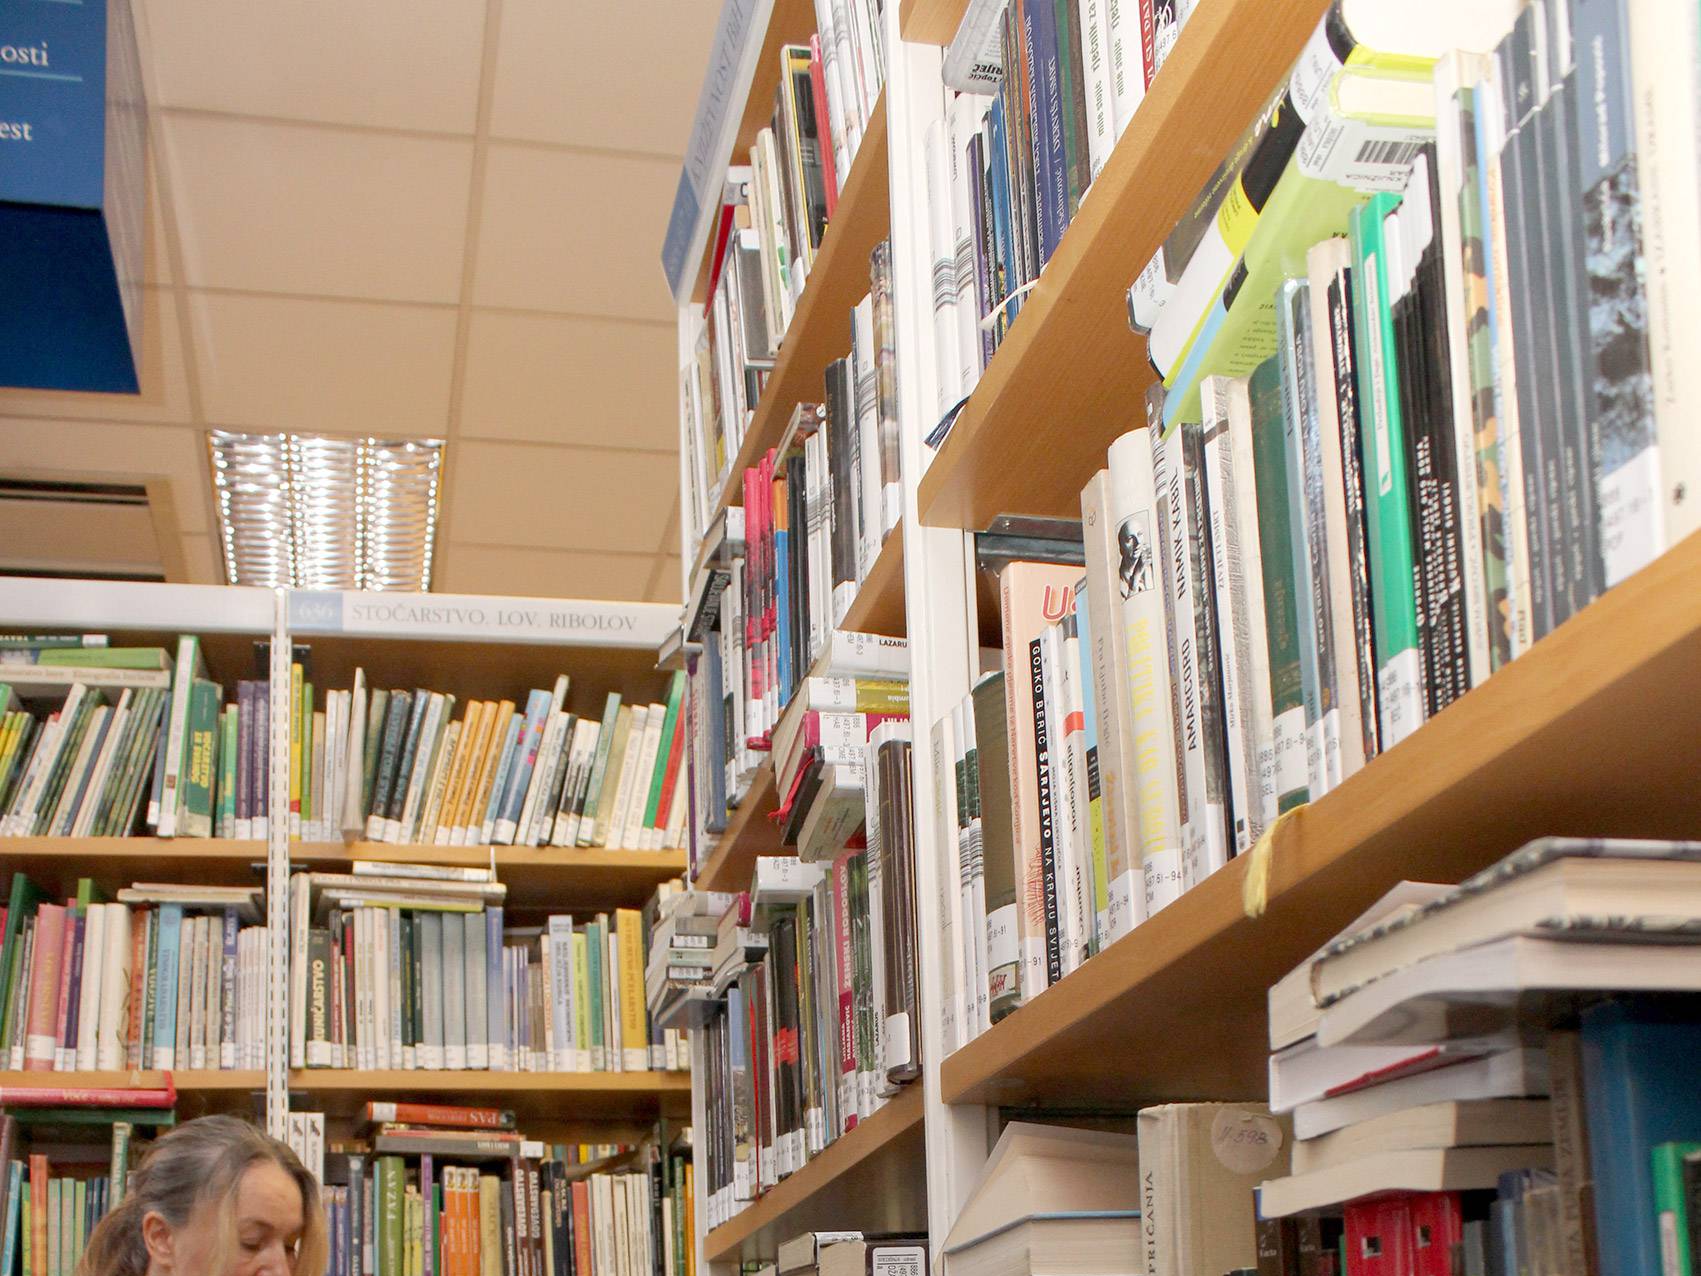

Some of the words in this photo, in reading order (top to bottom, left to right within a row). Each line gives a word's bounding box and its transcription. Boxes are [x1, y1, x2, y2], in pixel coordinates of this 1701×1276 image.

[1168, 467, 1182, 531] KABIL
[1171, 531, 1187, 600] NAMIK
[550, 612, 638, 632] RIBOLOV
[1030, 646, 1042, 695] GOJKO
[1181, 639, 1197, 752] AMARCORD
[1034, 700, 1047, 745] BERIĆ
[1039, 752, 1051, 839] SARAJEVO
[1066, 743, 1078, 832] Hodoljublja
[1044, 848, 1055, 865] NA
[839, 865, 849, 937] RODOSLOV
[1046, 873, 1057, 919] KRAJU
[842, 939, 853, 989] ŽENSKI
